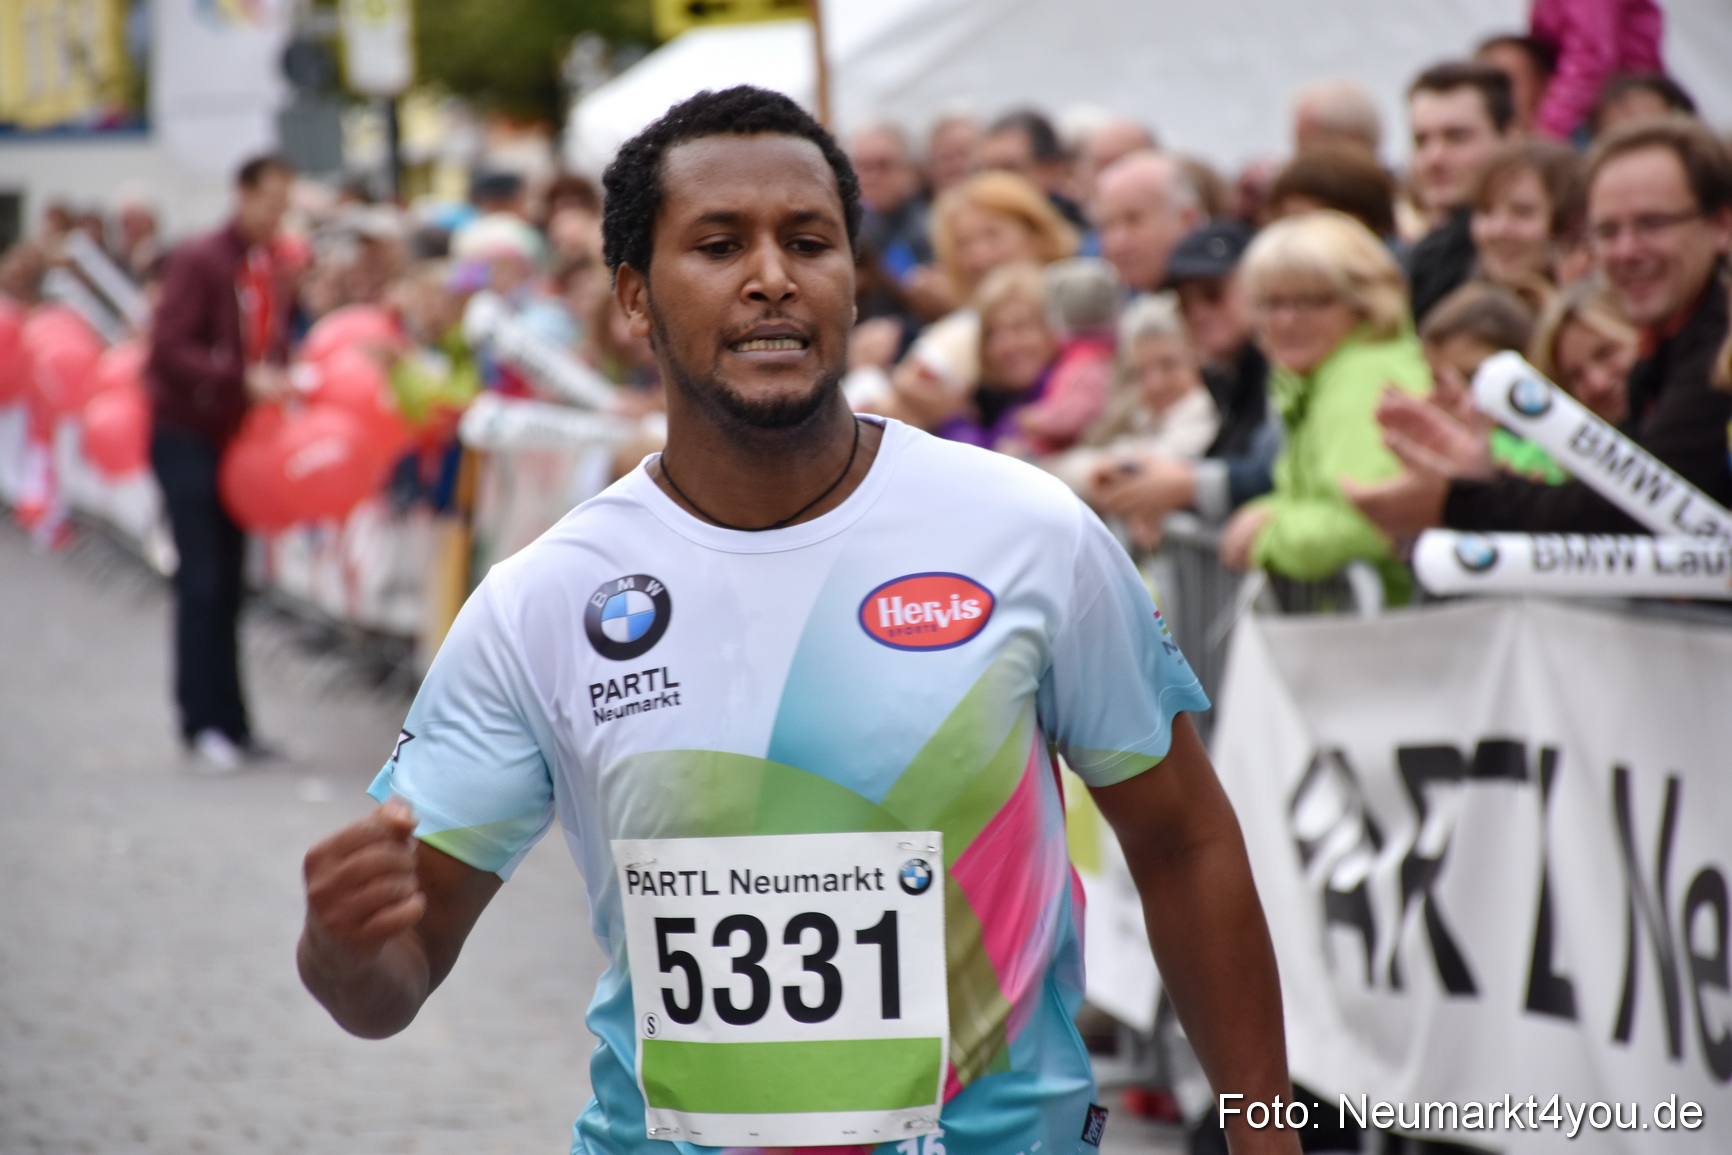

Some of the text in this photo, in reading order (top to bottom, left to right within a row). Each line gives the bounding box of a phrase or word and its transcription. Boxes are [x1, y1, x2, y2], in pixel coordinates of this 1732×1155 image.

[1569, 413, 1732, 547] BMW La
[1532, 534, 1732, 576] BMW Lau
[590, 577, 664, 609] BMW
[876, 593, 983, 628] Hervis
[887, 624, 939, 637] SPORTS
[588, 666, 680, 708] PARTL
[593, 690, 682, 727] Neumarkt
[625, 866, 885, 896] PARTL Neumarkt
[653, 909, 902, 1026] 5331
